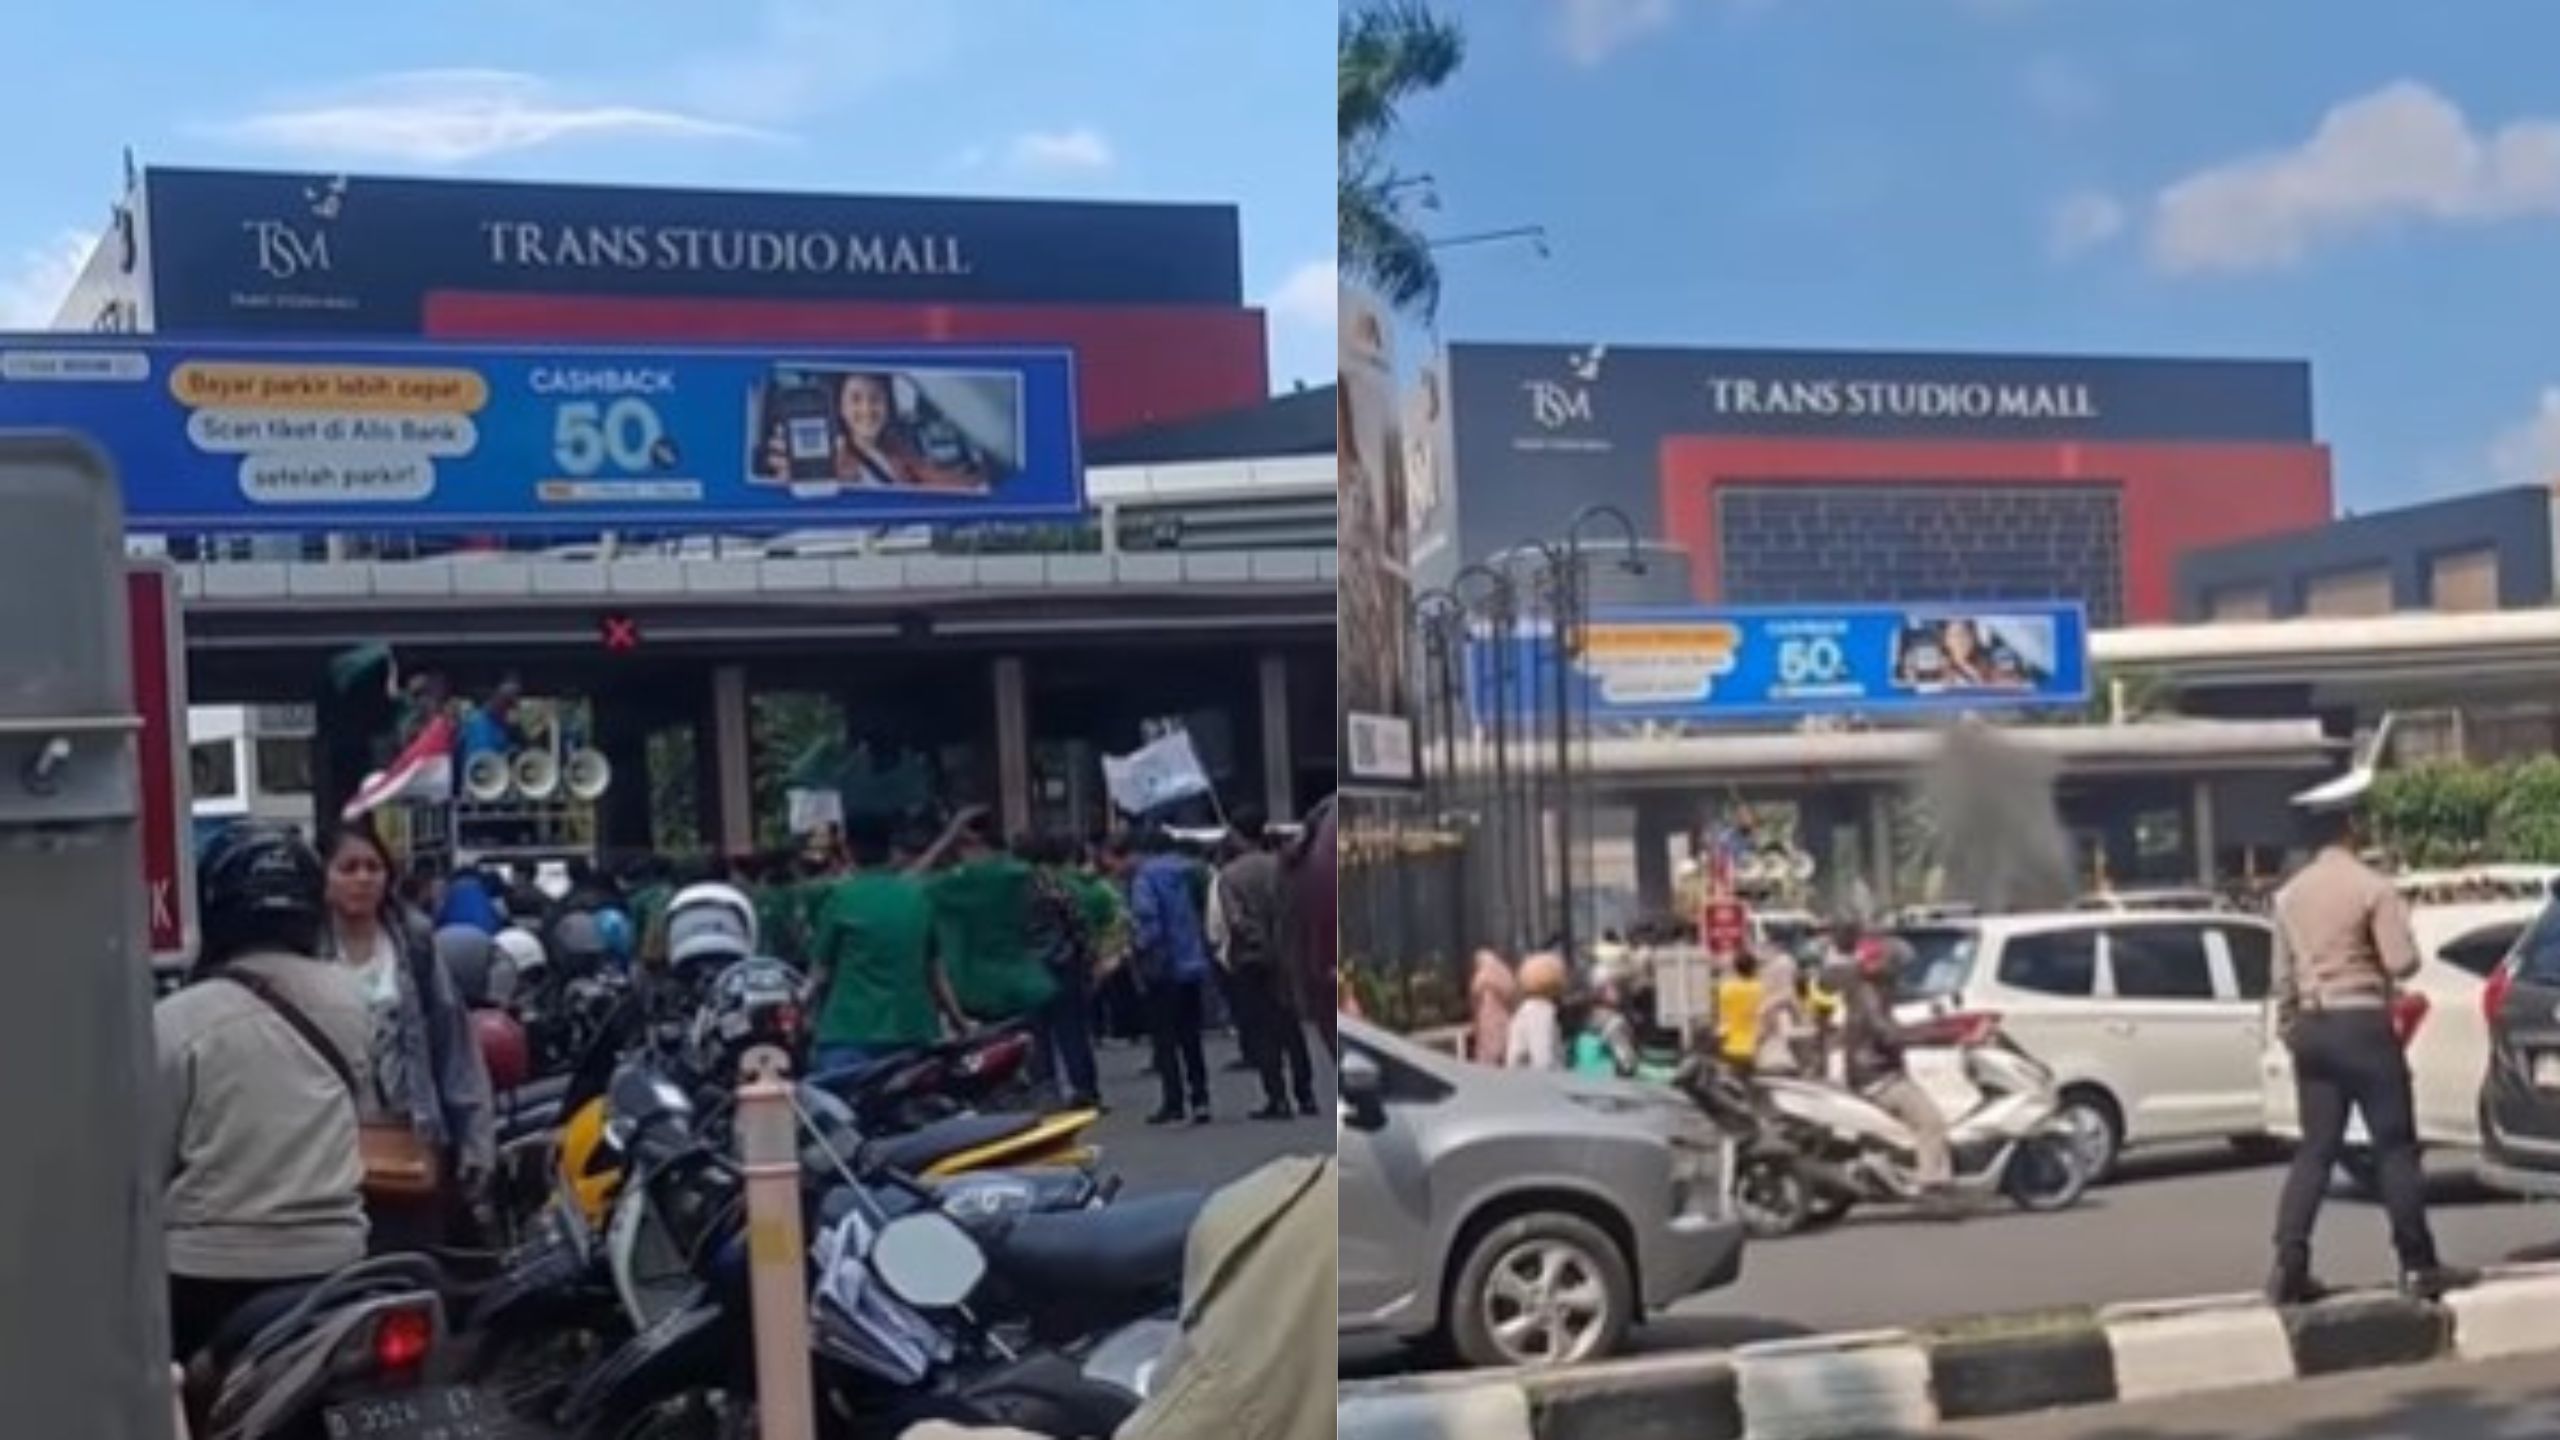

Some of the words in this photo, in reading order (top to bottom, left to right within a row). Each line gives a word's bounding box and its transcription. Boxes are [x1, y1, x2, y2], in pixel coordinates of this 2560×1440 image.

[243, 219, 331, 278] TSM
[481, 221, 648, 268] TRANS
[655, 226, 839, 271] STUDIO
[847, 233, 972, 275] MALL
[261, 374, 329, 397] parkir
[529, 367, 676, 393] CASHBACK
[1707, 377, 1839, 414] TRANS
[1844, 379, 1991, 416] STUDIO
[1997, 384, 2097, 418] MALL
[202, 417, 261, 440] Scan
[322, 421, 346, 440] di
[401, 423, 456, 440] Bank
[255, 465, 334, 486] setelah
